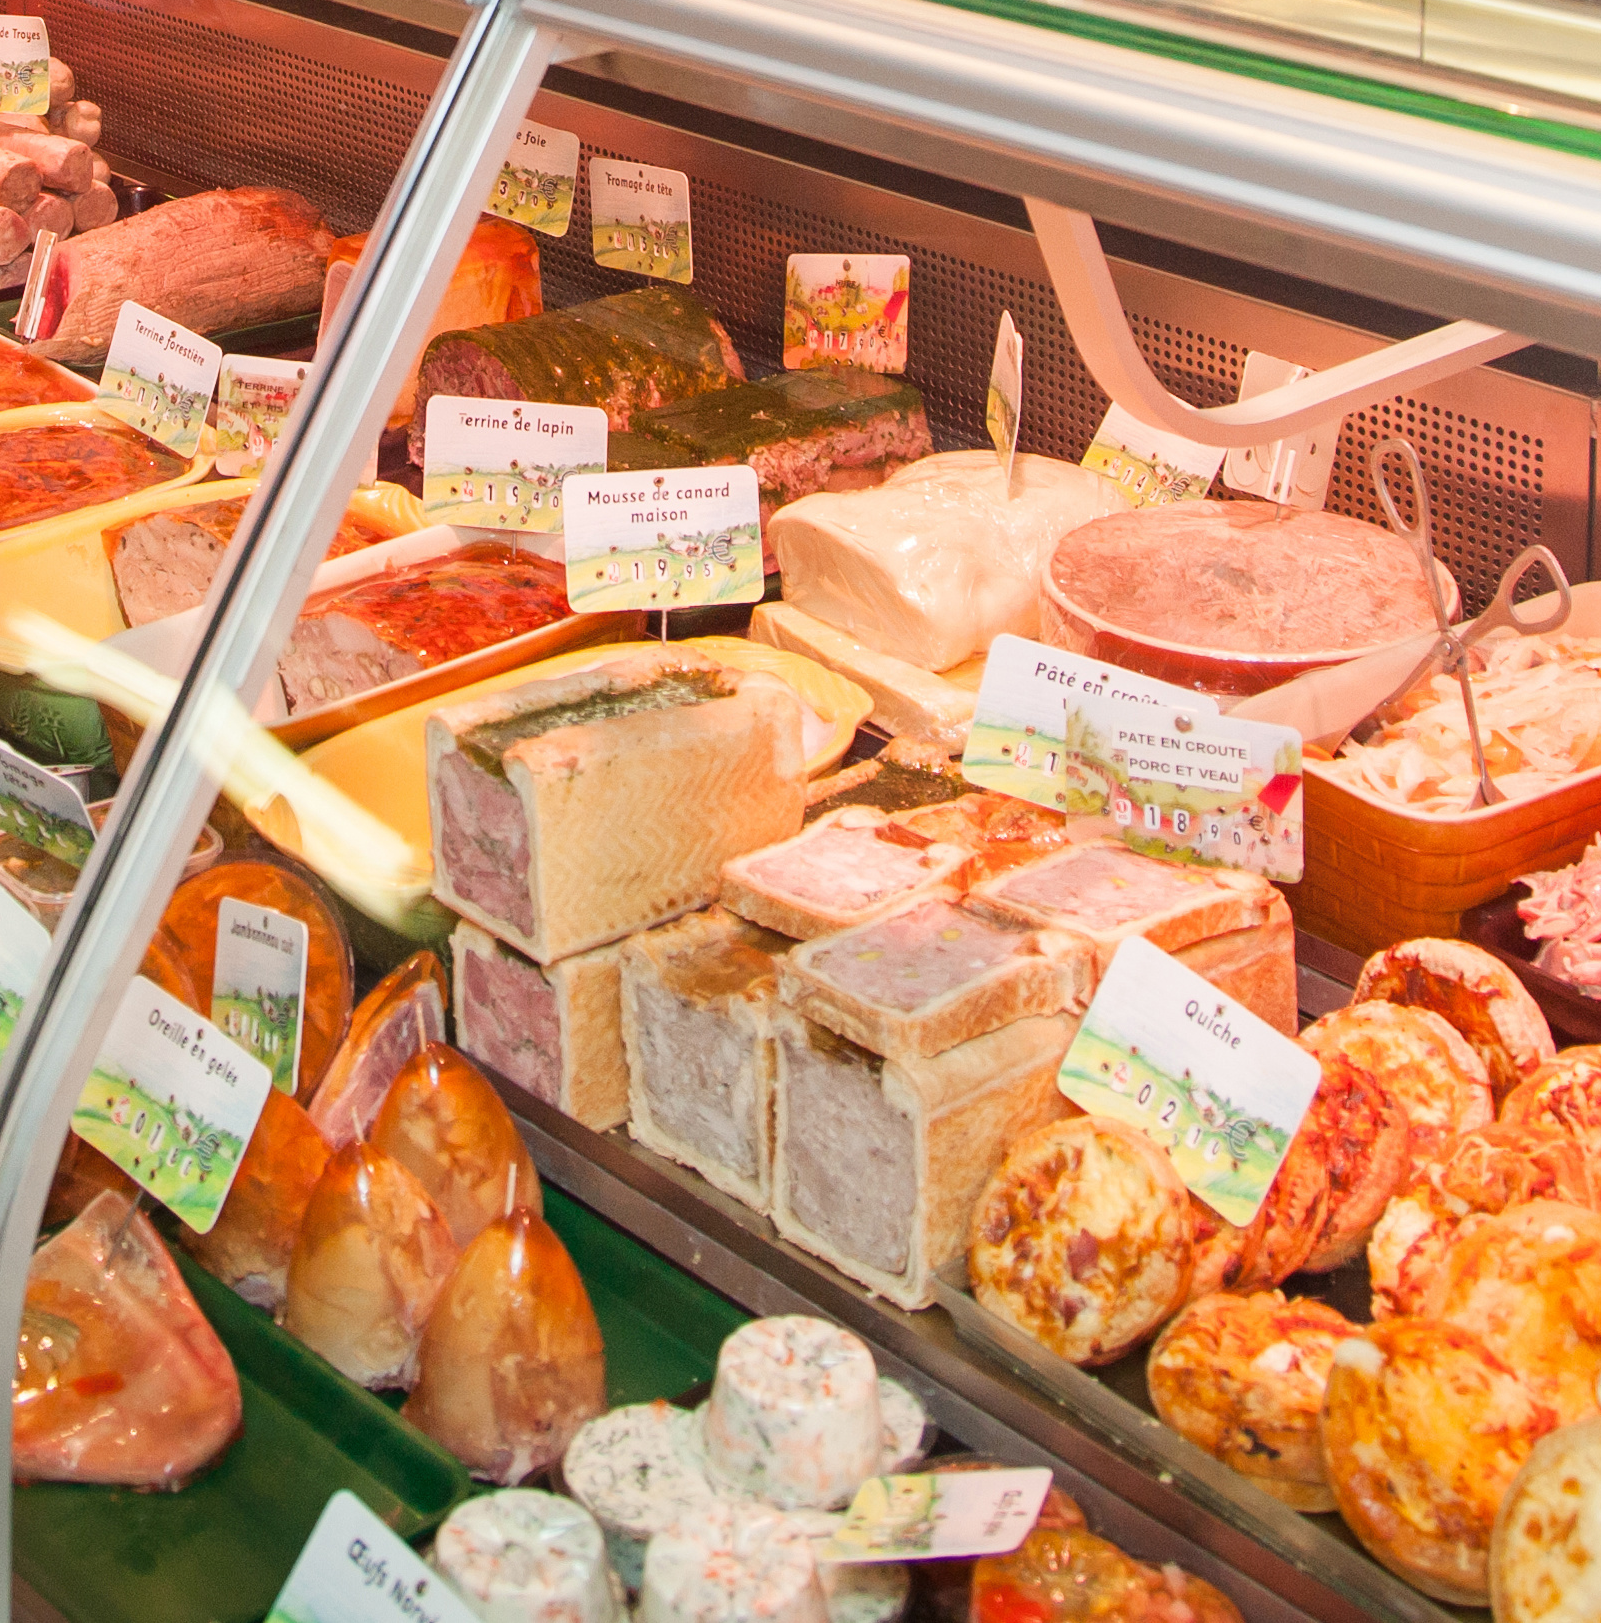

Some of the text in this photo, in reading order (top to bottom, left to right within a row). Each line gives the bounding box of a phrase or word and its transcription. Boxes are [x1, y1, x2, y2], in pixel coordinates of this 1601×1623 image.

[0, 28, 9, 38] de
[12, 29, 41, 43] Troyes
[523, 131, 547, 148] foie
[605, 172, 673, 197] Fromage de tête
[136, 319, 206, 367] Terrine forestière
[238, 380, 284, 393] TERRINE
[267, 402, 284, 413] RIS
[459, 412, 574, 437] Terrine de lapin
[588, 482, 730, 505] Mousse de canard
[631, 508, 688, 524] maison
[1034, 661, 1077, 688] Pâté
[1082, 678, 1103, 696] en
[1118, 730, 1248, 761] PATE EN CROUTE
[3, 772, 28, 791] tête
[1129, 757, 1240, 785] PORC ET VEAU
[1184, 1000, 1241, 1049] Quiche
[148, 1007, 191, 1050] Oreille
[190, 1042, 207, 1064] en
[207, 1053, 240, 1089] gelée
